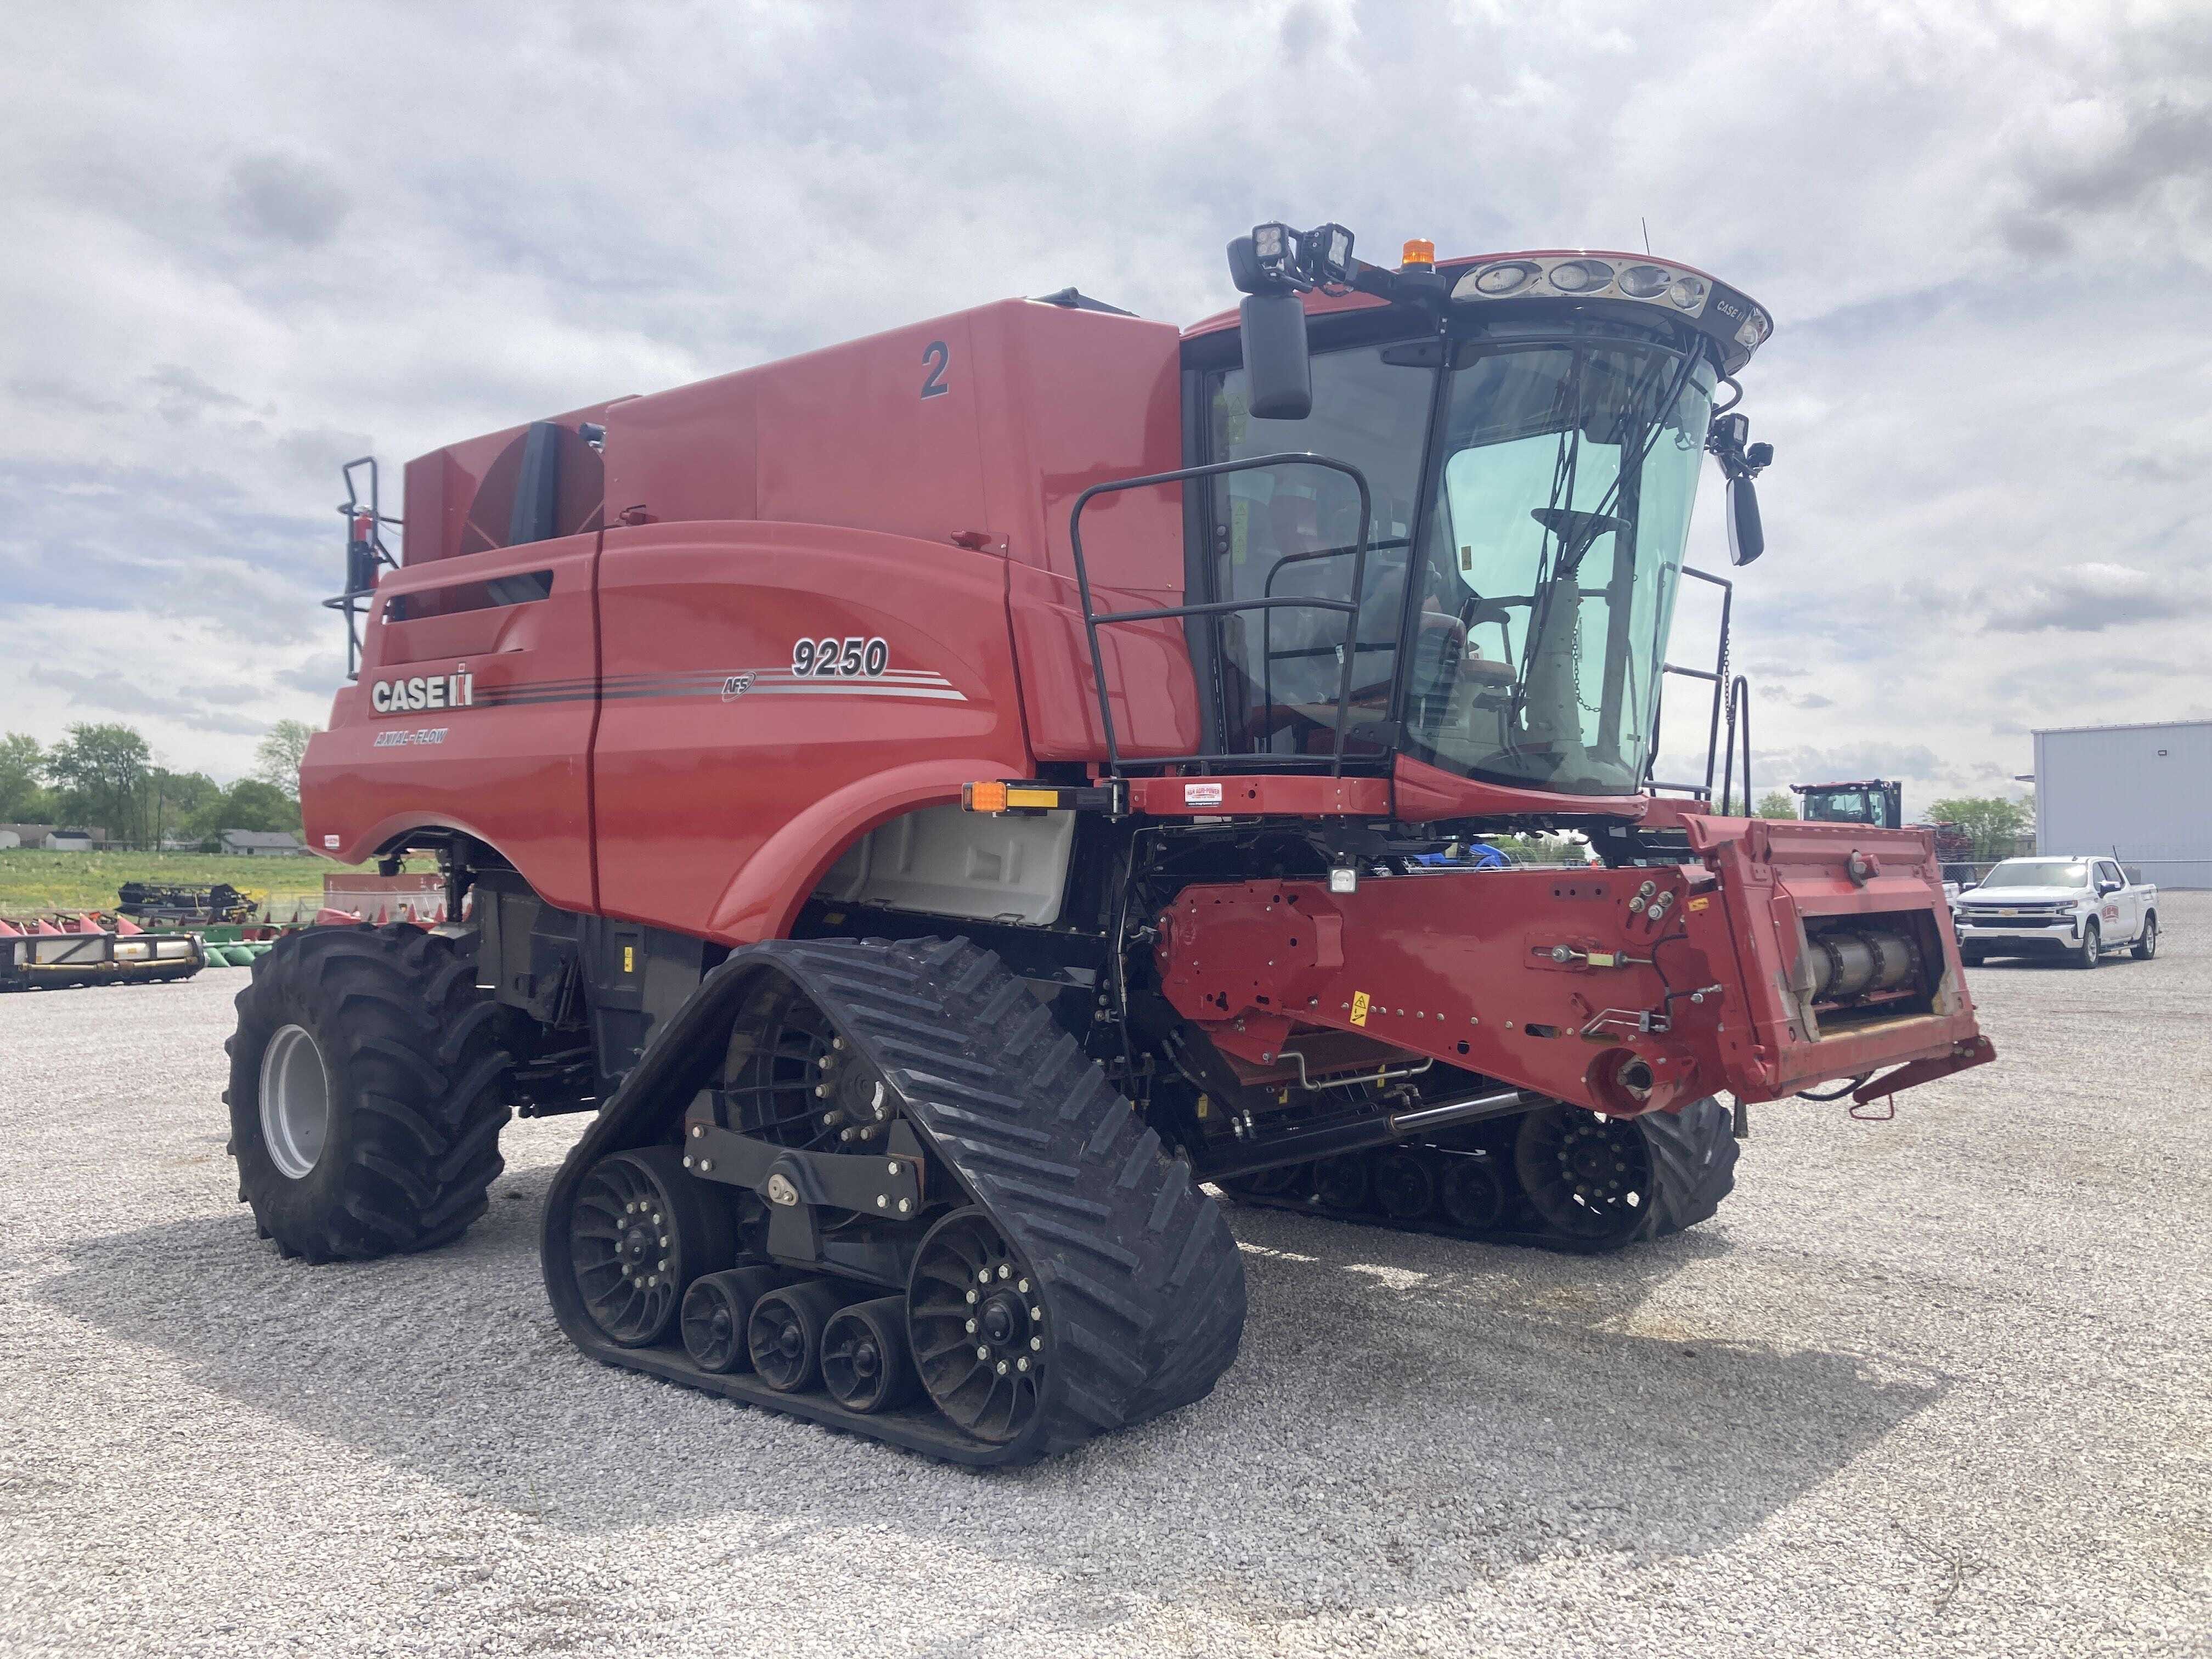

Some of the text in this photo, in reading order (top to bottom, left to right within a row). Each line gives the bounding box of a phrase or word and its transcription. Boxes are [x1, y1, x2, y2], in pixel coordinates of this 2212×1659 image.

[1717, 300, 1739, 318] CASE
[921, 340, 949, 400] 2
[791, 636, 888, 678] 9250
[372, 675, 445, 713] CASE
[721, 675, 750, 695] AFS
[374, 727, 448, 747] AXIAL-FLOW
